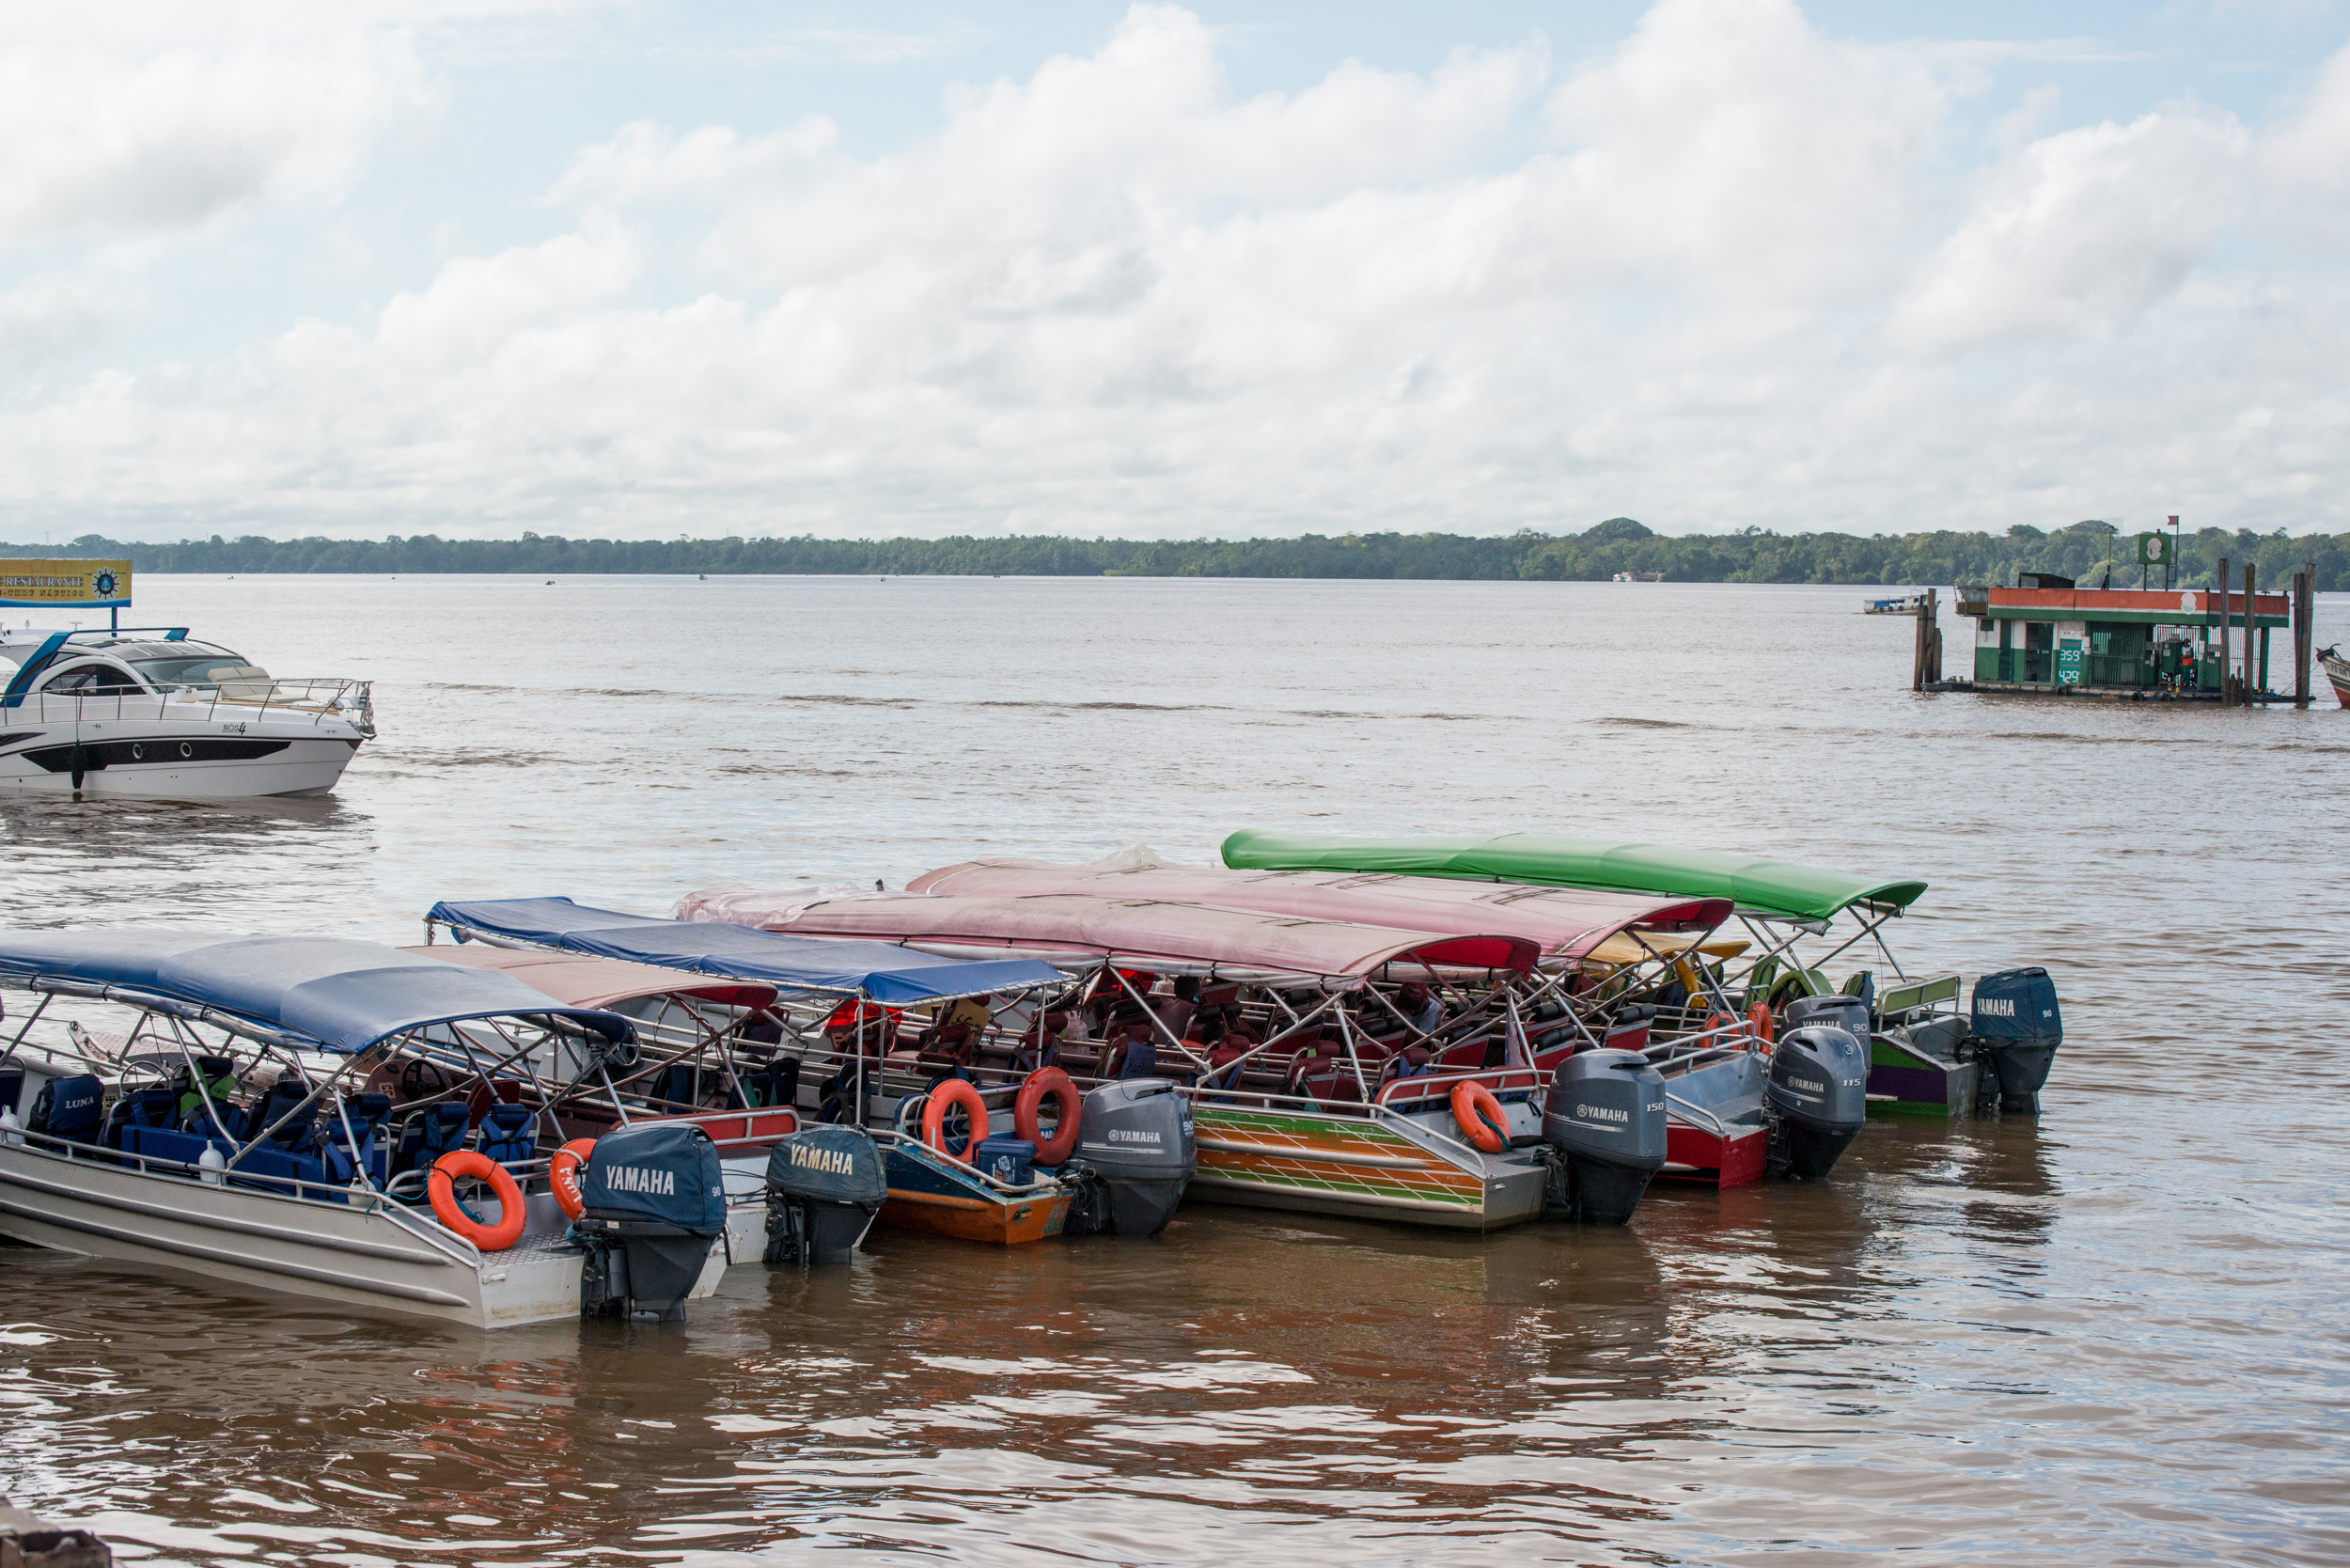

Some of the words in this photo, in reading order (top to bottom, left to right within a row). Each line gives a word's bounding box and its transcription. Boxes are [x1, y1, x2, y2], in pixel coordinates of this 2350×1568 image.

[6, 576, 84, 587] RESTAURANTE
[1977, 998, 2015, 1016] YAMAHA
[2043, 1010, 2052, 1018] 90
[1853, 1024, 1867, 1032] 90
[1794, 1078, 1824, 1092] YAMAHA
[1843, 1078, 1861, 1087] 115
[65, 1095, 94, 1109] LUNA
[1646, 1102, 1664, 1112] 150
[1589, 1105, 1628, 1122] YAMAHA
[1183, 1121, 1194, 1131] 90
[1120, 1131, 1161, 1143] YAMAHA
[791, 1144, 853, 1176] YAMAHA
[559, 1167, 583, 1202] LUNA
[606, 1165, 675, 1196] YAMAHA
[712, 1186, 721, 1197] 90
